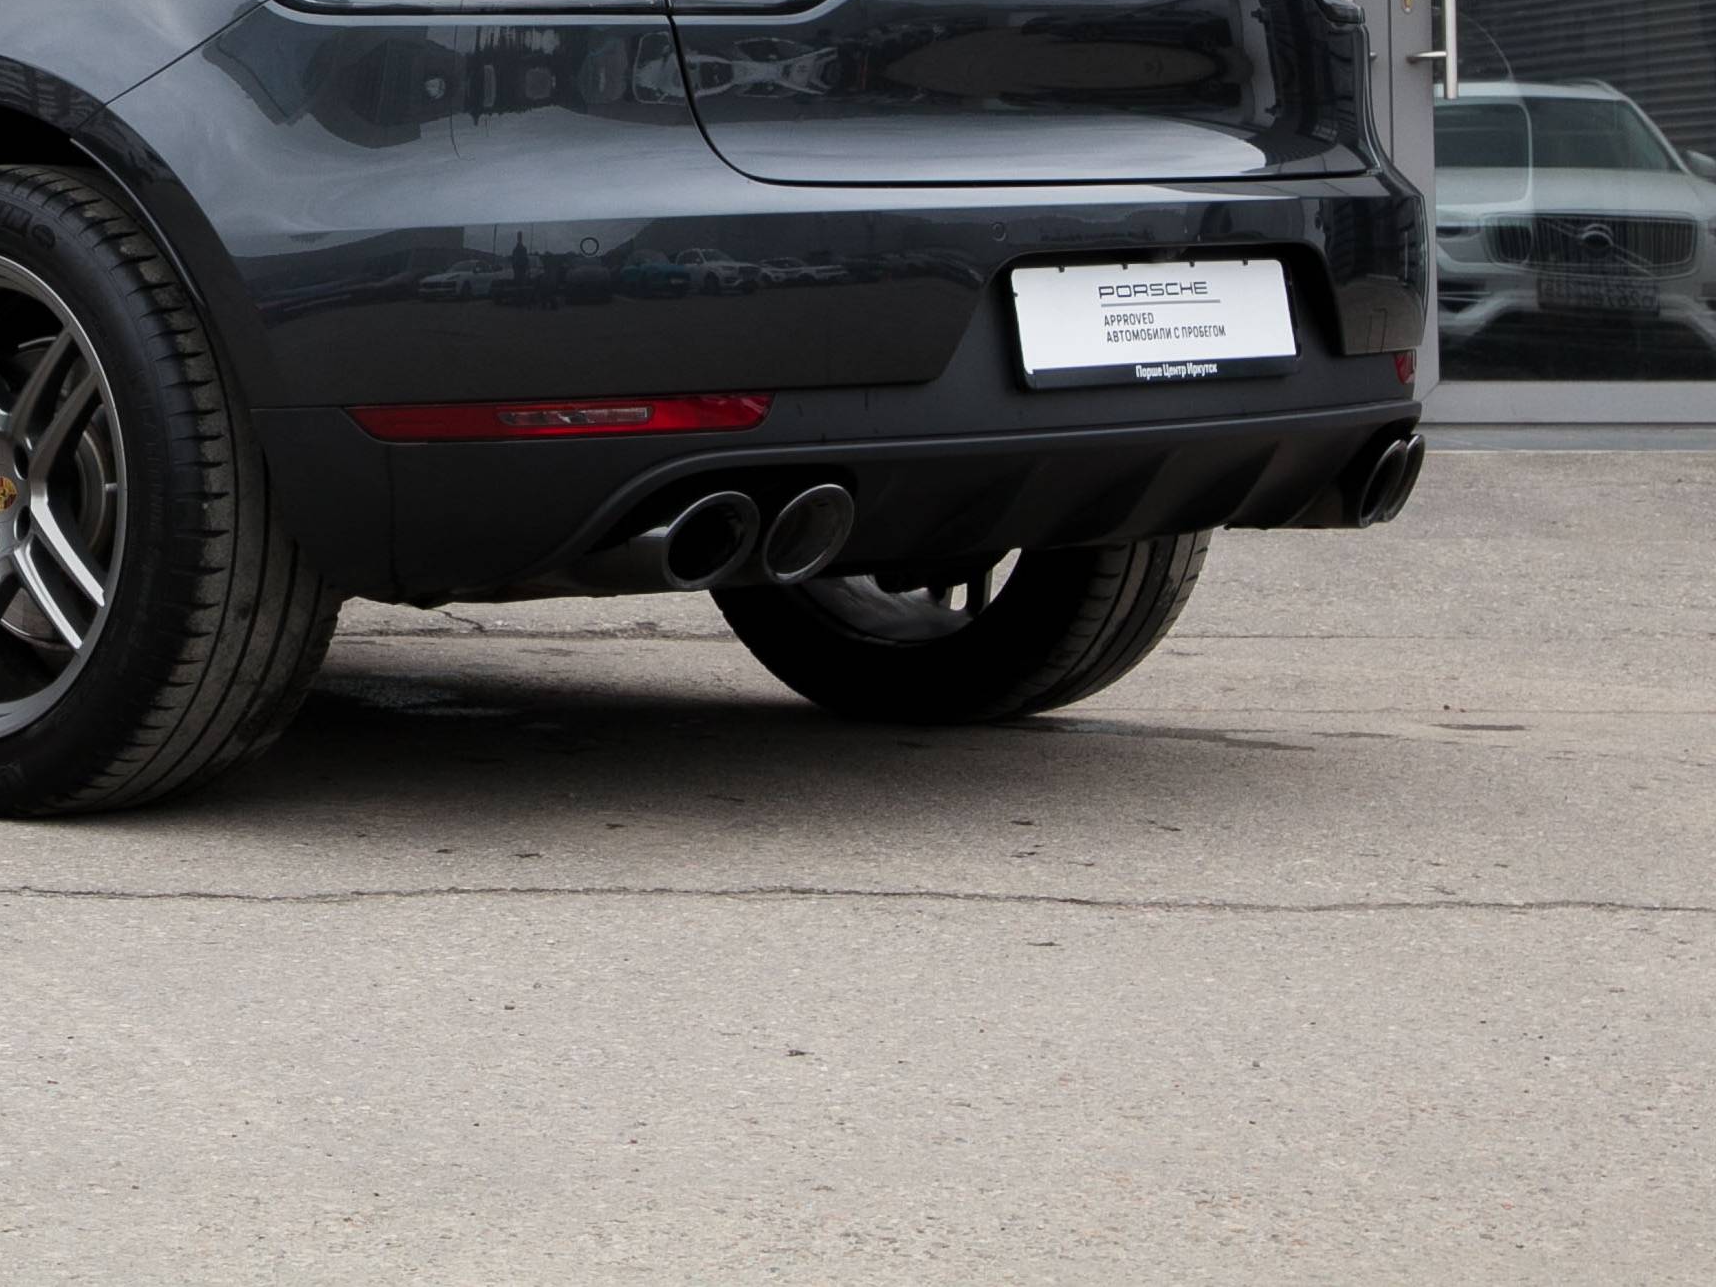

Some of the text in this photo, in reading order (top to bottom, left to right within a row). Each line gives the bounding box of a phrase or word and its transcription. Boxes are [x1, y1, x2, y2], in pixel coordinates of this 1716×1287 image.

[1098, 281, 1209, 300] PORSCHE
[1103, 312, 1155, 327] APPROVED
[1106, 327, 1172, 344] АВТОМОБИЛИ
[1182, 325, 1226, 340] ПРОБЕГОМ
[1135, 362, 1218, 380] Порше Центр Иркутск
